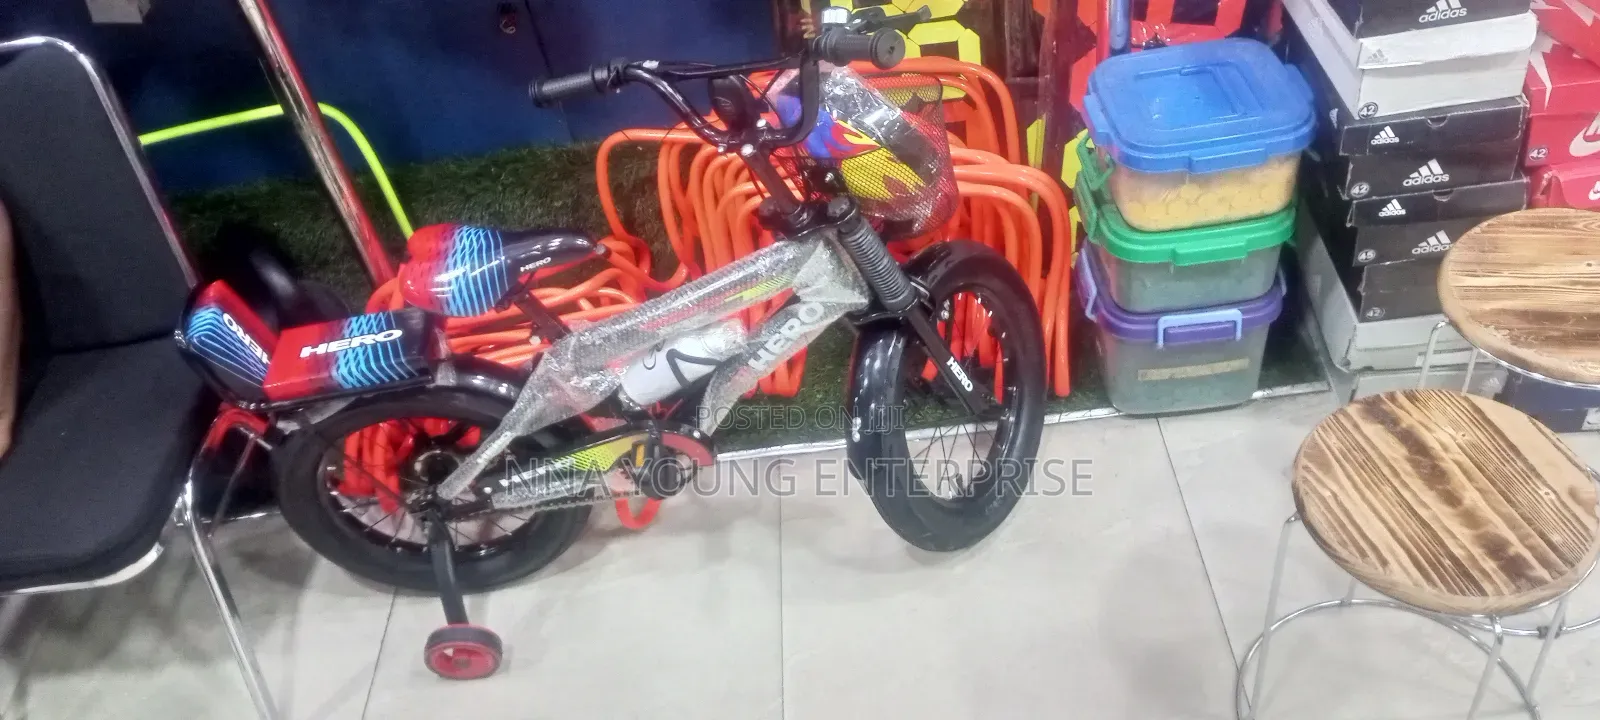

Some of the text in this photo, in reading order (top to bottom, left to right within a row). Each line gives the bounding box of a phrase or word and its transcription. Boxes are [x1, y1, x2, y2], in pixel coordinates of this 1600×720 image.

[1419, 7, 1467, 23] adidas
[1370, 136, 1399, 145] adidas
[1530, 148, 1547, 158] 42
[1402, 174, 1450, 186] adidas
[1378, 208, 1406, 217] adidas
[1412, 244, 1453, 254] adida
[520, 257, 551, 272] HERO
[748, 301, 824, 371] HERO
[300, 330, 402, 358] HERO
[946, 356, 973, 391] HERO
